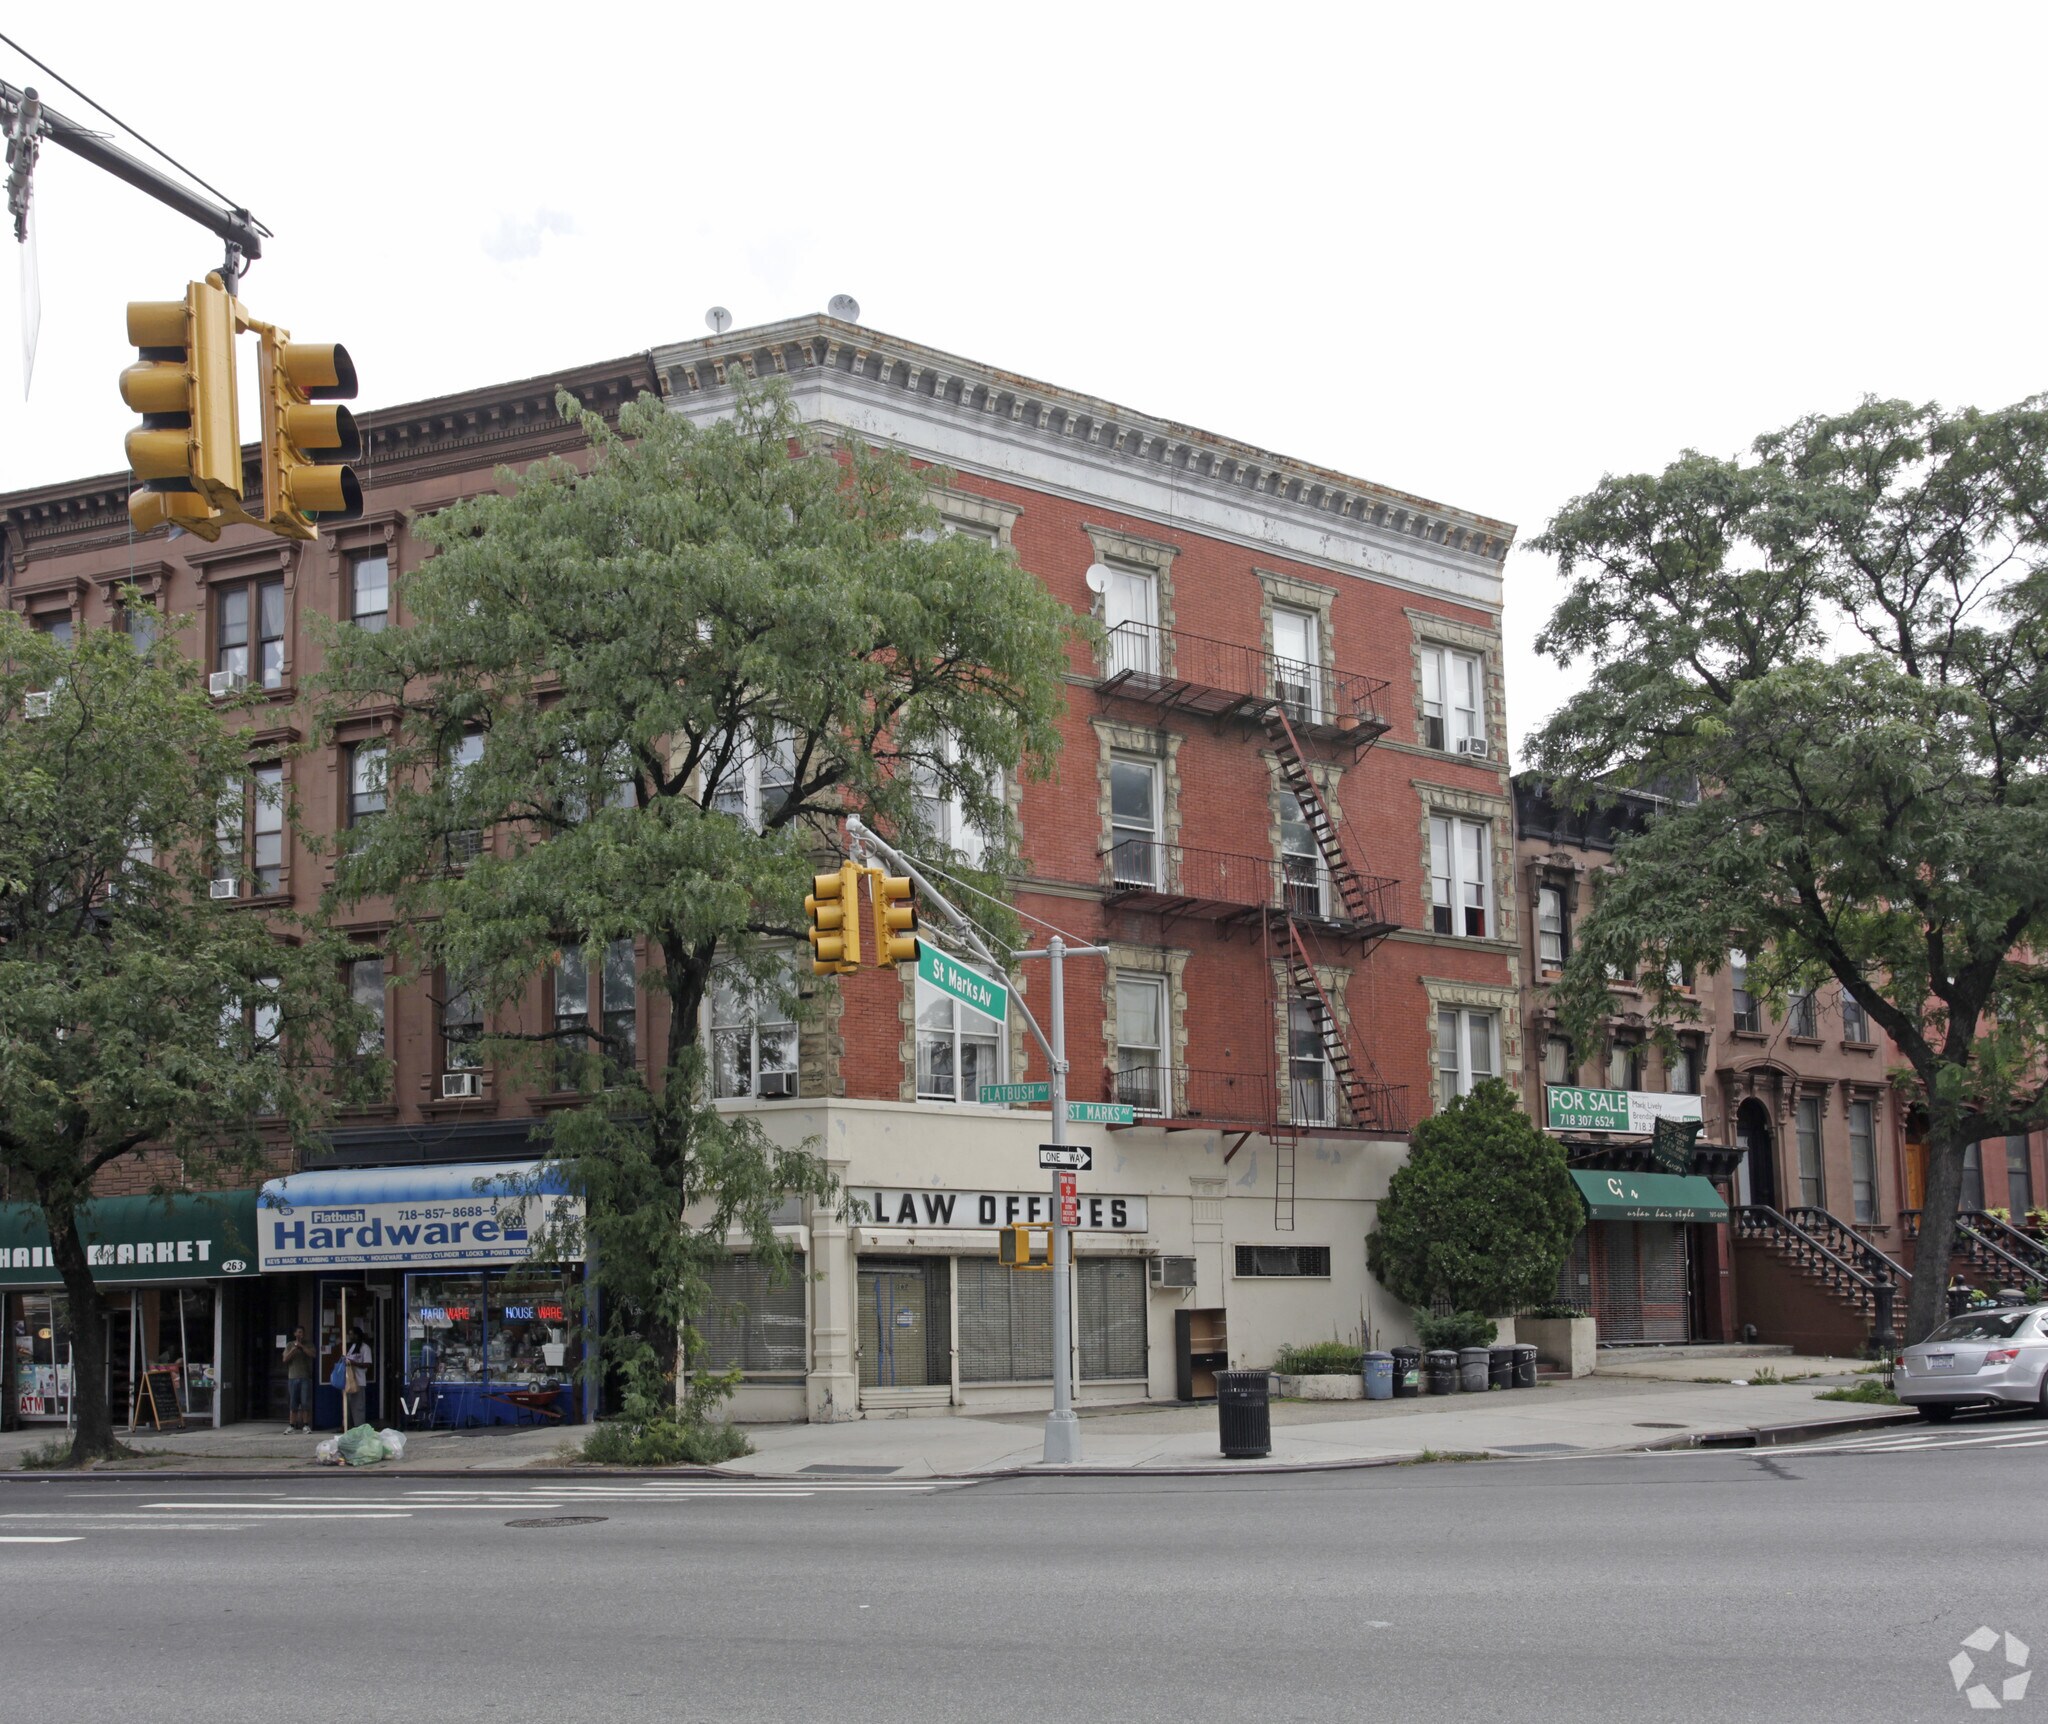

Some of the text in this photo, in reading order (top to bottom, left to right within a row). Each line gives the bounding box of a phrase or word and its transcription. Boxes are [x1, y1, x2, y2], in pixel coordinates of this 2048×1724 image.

[933, 958, 991, 1007] St Marks Av
[981, 1084, 1047, 1101] FLATBUSH AV
[1551, 1090, 1626, 1112] FOR SALE
[1068, 1105, 1130, 1121] ST MARKS AV
[1560, 1114, 1614, 1127] 718 307 6524
[1634, 1122, 1647, 1132] 718
[1046, 1152, 1084, 1163] ONE WAY
[313, 1211, 363, 1223] Flatbush
[398, 1206, 498, 1220] 718-857-8688-9
[875, 1192, 957, 1225] LAW
[979, 1195, 1128, 1228] OFFIES
[275, 1217, 499, 1250] Hardware
[87, 1240, 212, 1266] MARKET
[226, 1261, 244, 1271] 263
[421, 1307, 470, 1320] HARD WARE
[506, 1307, 563, 1319] HOUSE WARE
[20, 1397, 44, 1411] ATM
